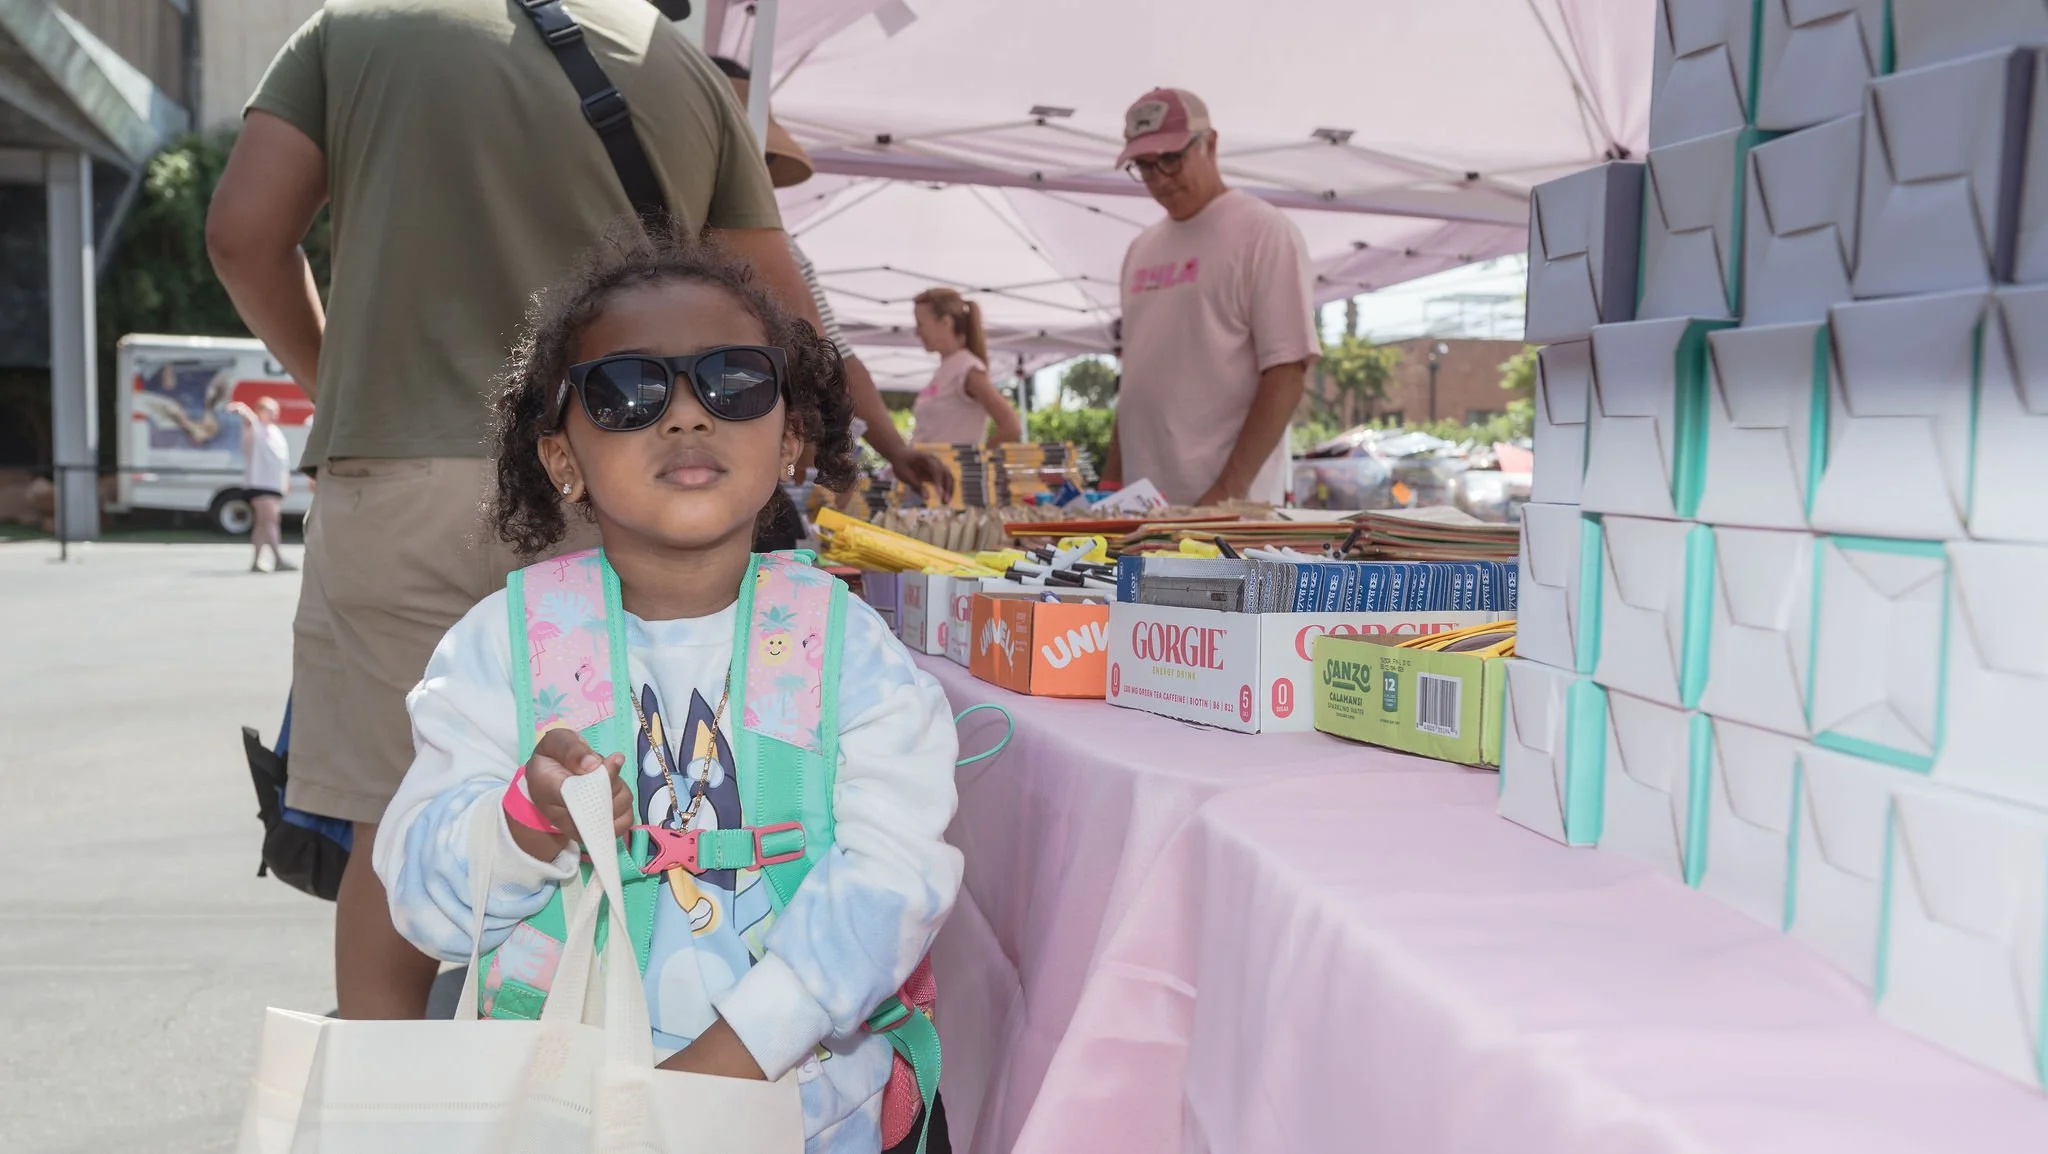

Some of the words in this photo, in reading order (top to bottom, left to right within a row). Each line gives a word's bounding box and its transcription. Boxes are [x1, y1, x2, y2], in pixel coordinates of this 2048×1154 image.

[1132, 621, 1225, 670] GORGIE
[1152, 666, 1174, 678] ENERGY
[1177, 669, 1196, 680] DRINK
[1323, 659, 1371, 693] SANZO
[1278, 683, 1288, 705] 0
[1384, 678, 1396, 692] 12
[1139, 687, 1153, 698] GREEN
[1153, 690, 1162, 699] TEA
[1163, 692, 1186, 704] CAFFEINE
[1190, 697, 1208, 708] BIOTIN
[1242, 690, 1249, 709] 5
[1329, 692, 1363, 707] CALAMANSI
